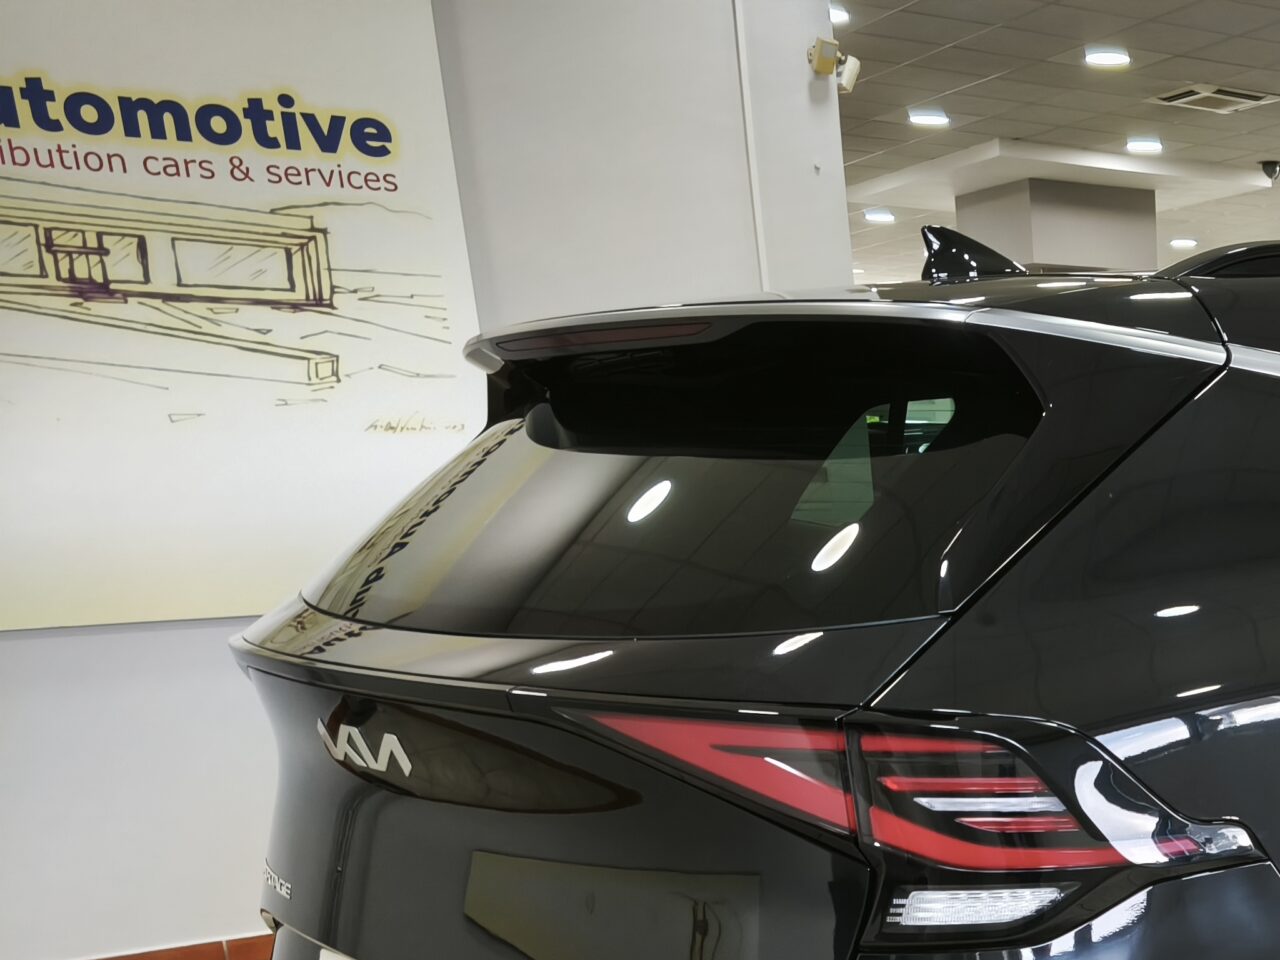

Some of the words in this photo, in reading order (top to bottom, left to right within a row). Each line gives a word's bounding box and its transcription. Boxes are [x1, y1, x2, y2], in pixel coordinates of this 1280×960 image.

[143, 155, 216, 180] cars
[229, 156, 255, 183] &
[266, 164, 398, 193] services
[317, 717, 413, 777] KIA
